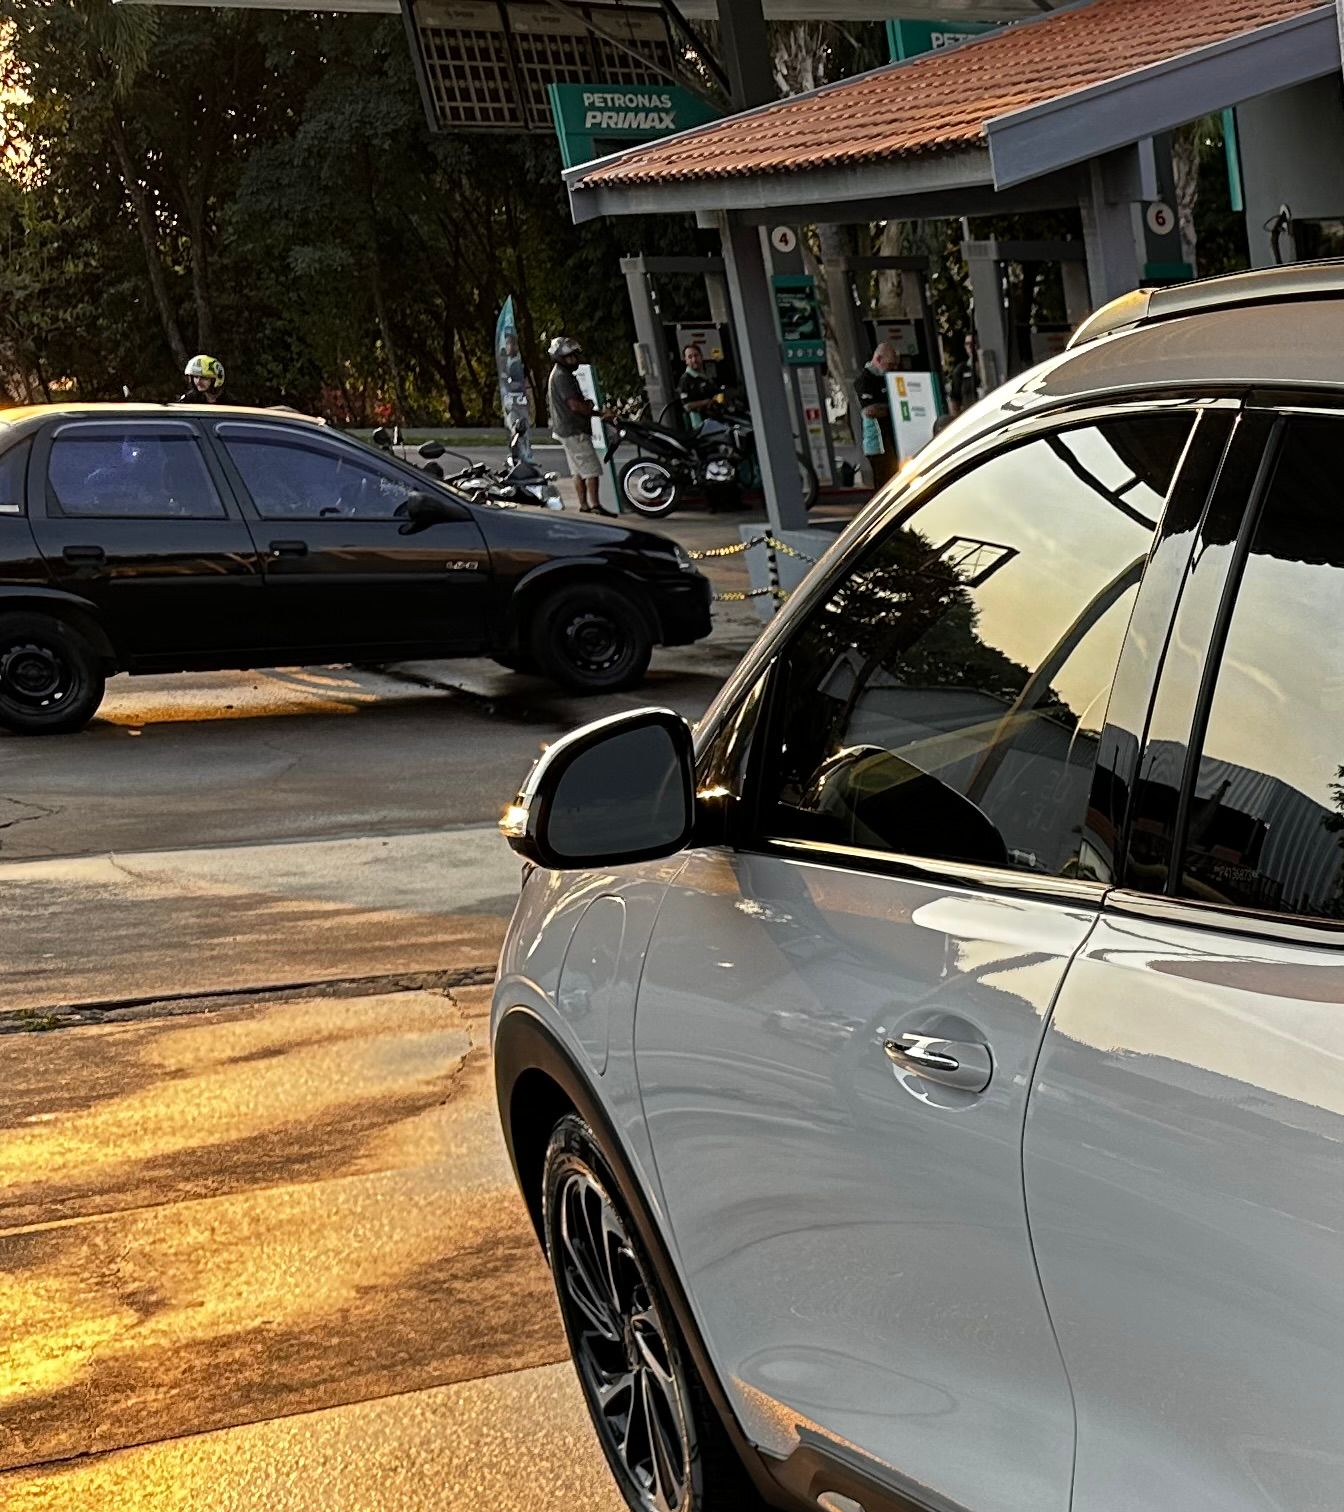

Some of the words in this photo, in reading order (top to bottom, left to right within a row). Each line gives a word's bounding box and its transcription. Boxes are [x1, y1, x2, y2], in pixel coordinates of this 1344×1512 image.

[583, 93, 671, 109] PETRONAS
[585, 111, 676, 129] PRIMAX
[1156, 210, 1165, 226] 6
[779, 231, 790, 246] 4
